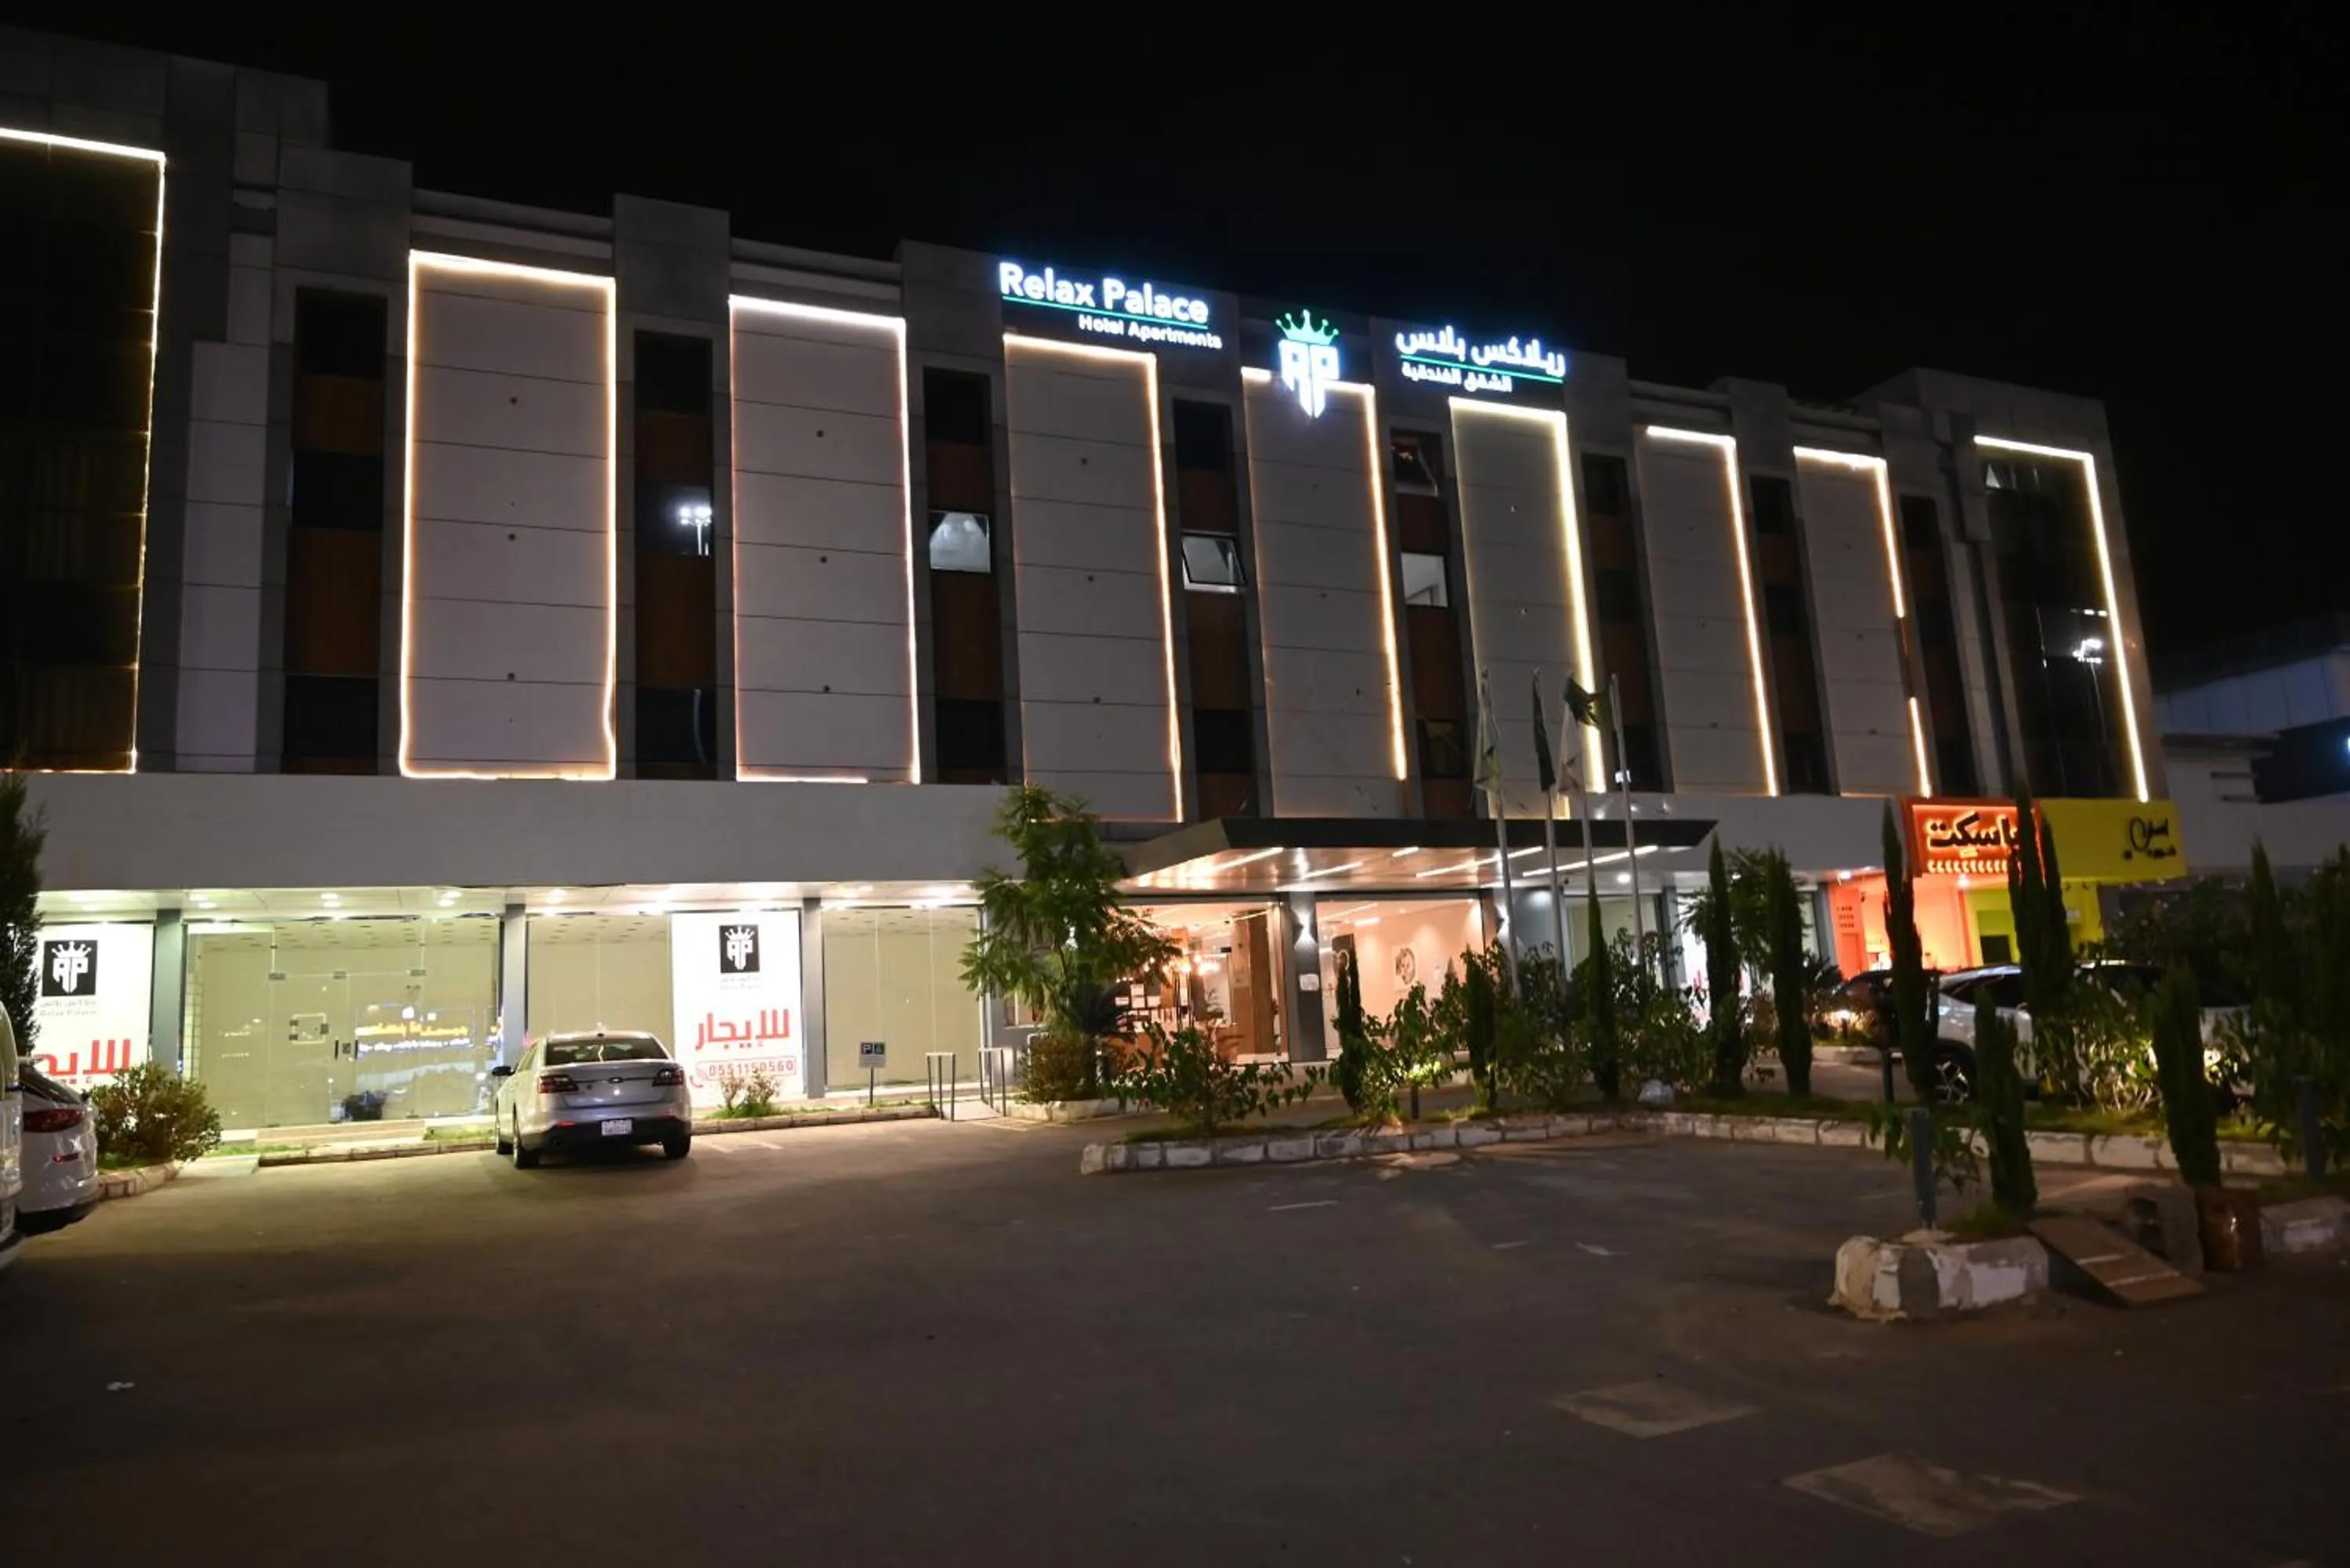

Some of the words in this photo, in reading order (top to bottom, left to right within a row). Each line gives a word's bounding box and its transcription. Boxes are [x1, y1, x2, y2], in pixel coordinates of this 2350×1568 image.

[999, 262, 1095, 308] Relax
[1102, 277, 1209, 323] Palace
[1079, 314, 1124, 335] Hotel
[1128, 320, 1223, 349] Apartments
